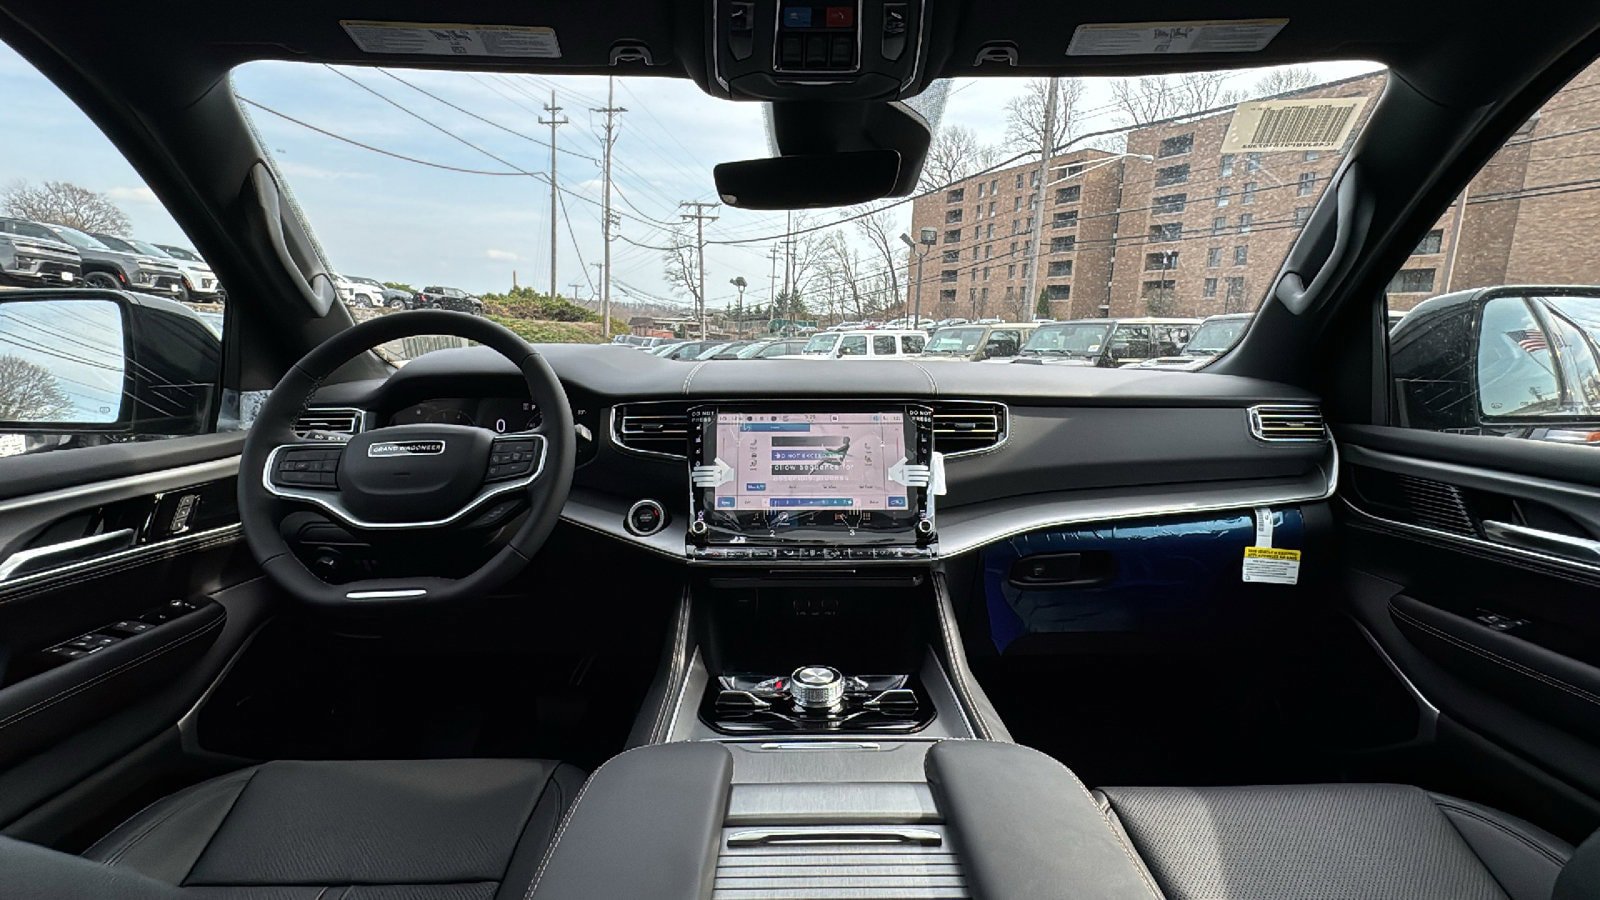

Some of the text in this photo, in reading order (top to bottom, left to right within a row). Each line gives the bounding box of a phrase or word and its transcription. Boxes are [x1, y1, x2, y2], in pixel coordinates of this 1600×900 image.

[496, 418, 506, 433] 0
[769, 529, 775, 538] 2
[849, 529, 856, 537] 3
